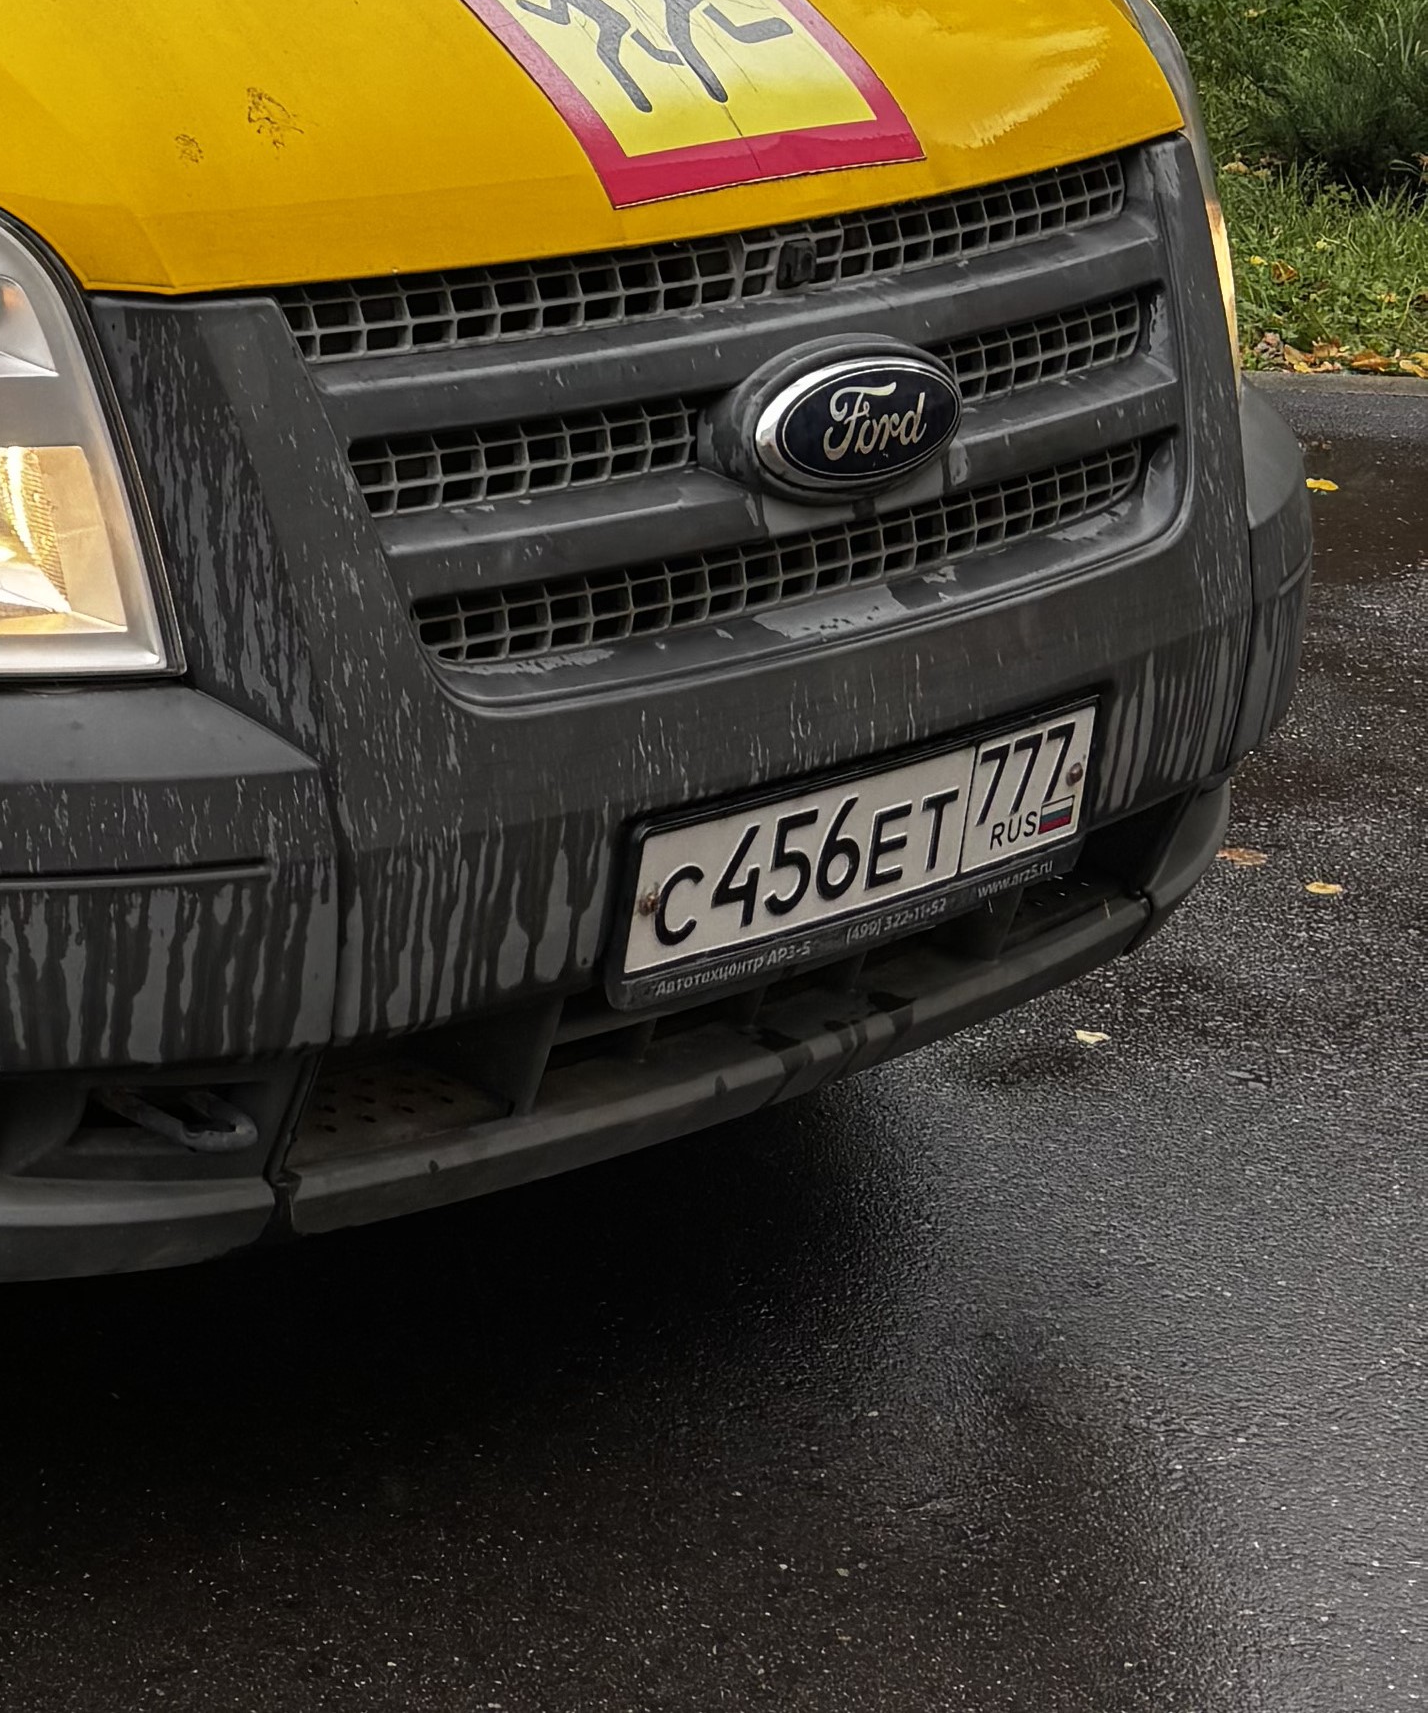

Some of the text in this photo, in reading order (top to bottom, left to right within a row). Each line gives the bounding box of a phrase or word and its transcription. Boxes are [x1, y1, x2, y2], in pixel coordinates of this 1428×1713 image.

[823, 381, 927, 461] Ford
[654, 721, 1077, 946] С456ЕТ 777
[989, 811, 1038, 851] RUS
